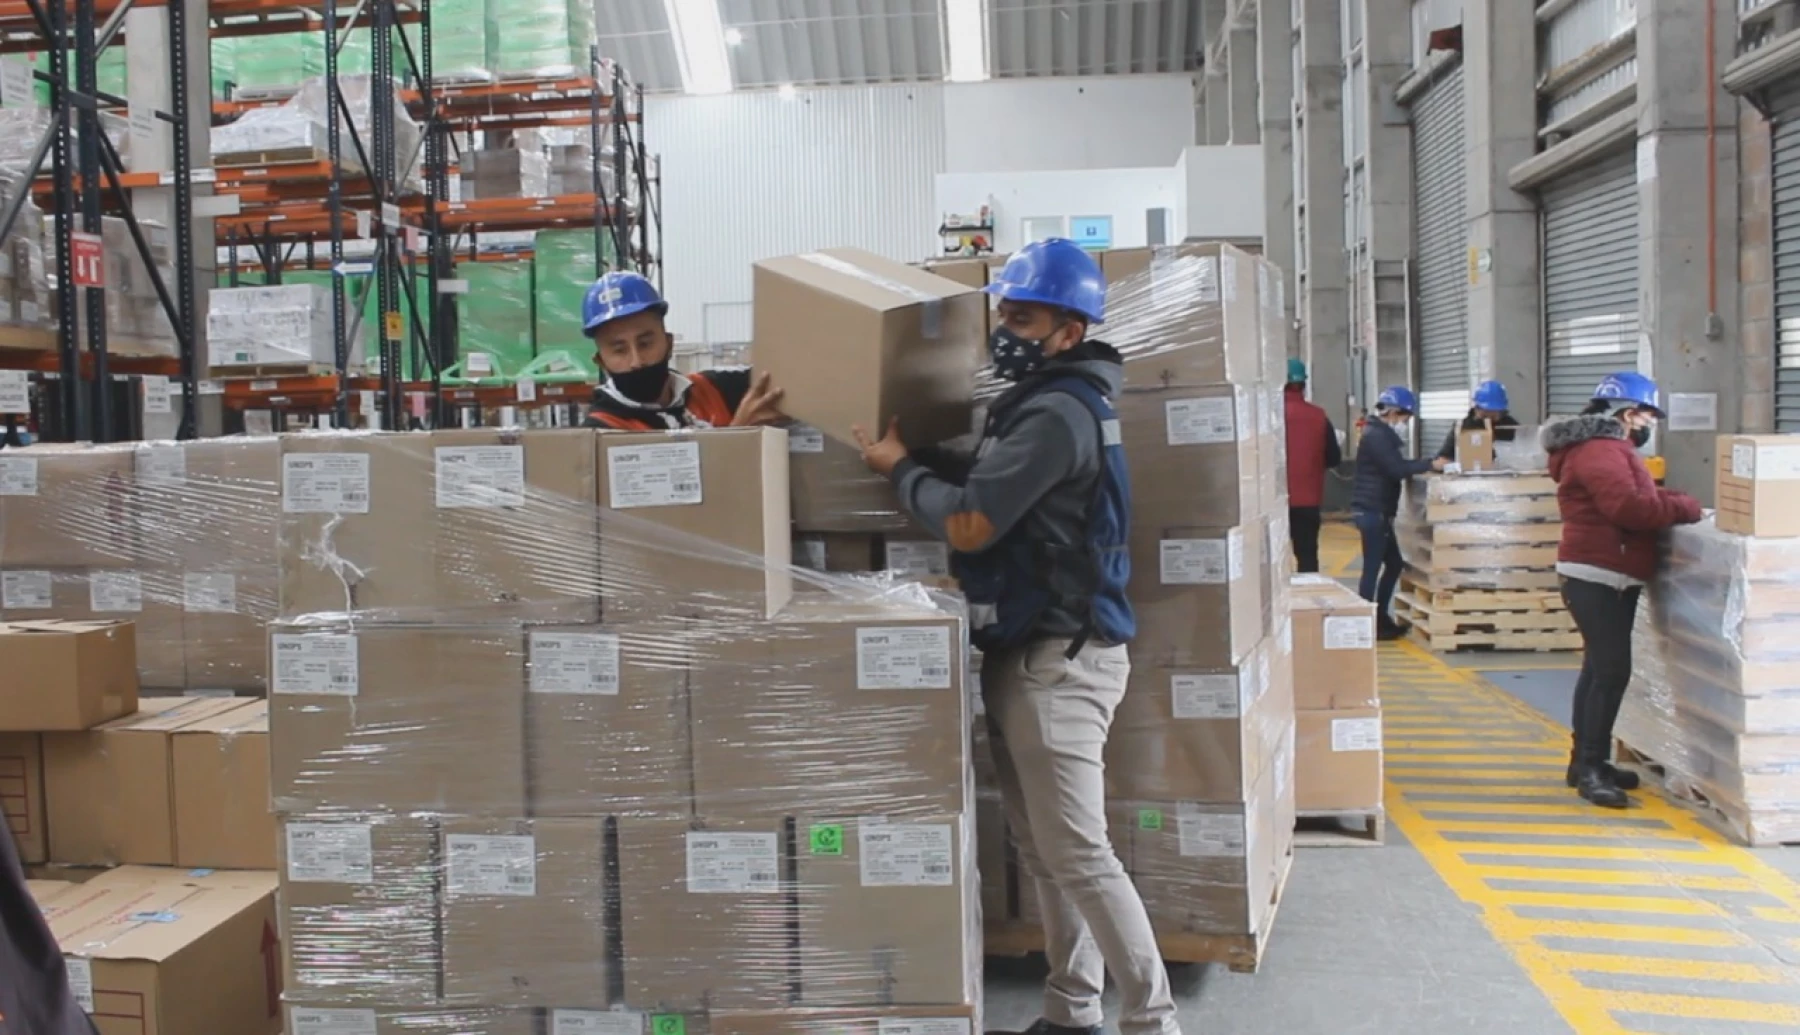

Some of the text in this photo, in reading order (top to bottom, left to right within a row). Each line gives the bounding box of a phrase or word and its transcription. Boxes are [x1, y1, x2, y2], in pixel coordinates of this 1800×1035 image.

[614, 454, 640, 462] UNOPS
[862, 636, 889, 644] UNOPS
[277, 643, 302, 651] UNOPS
